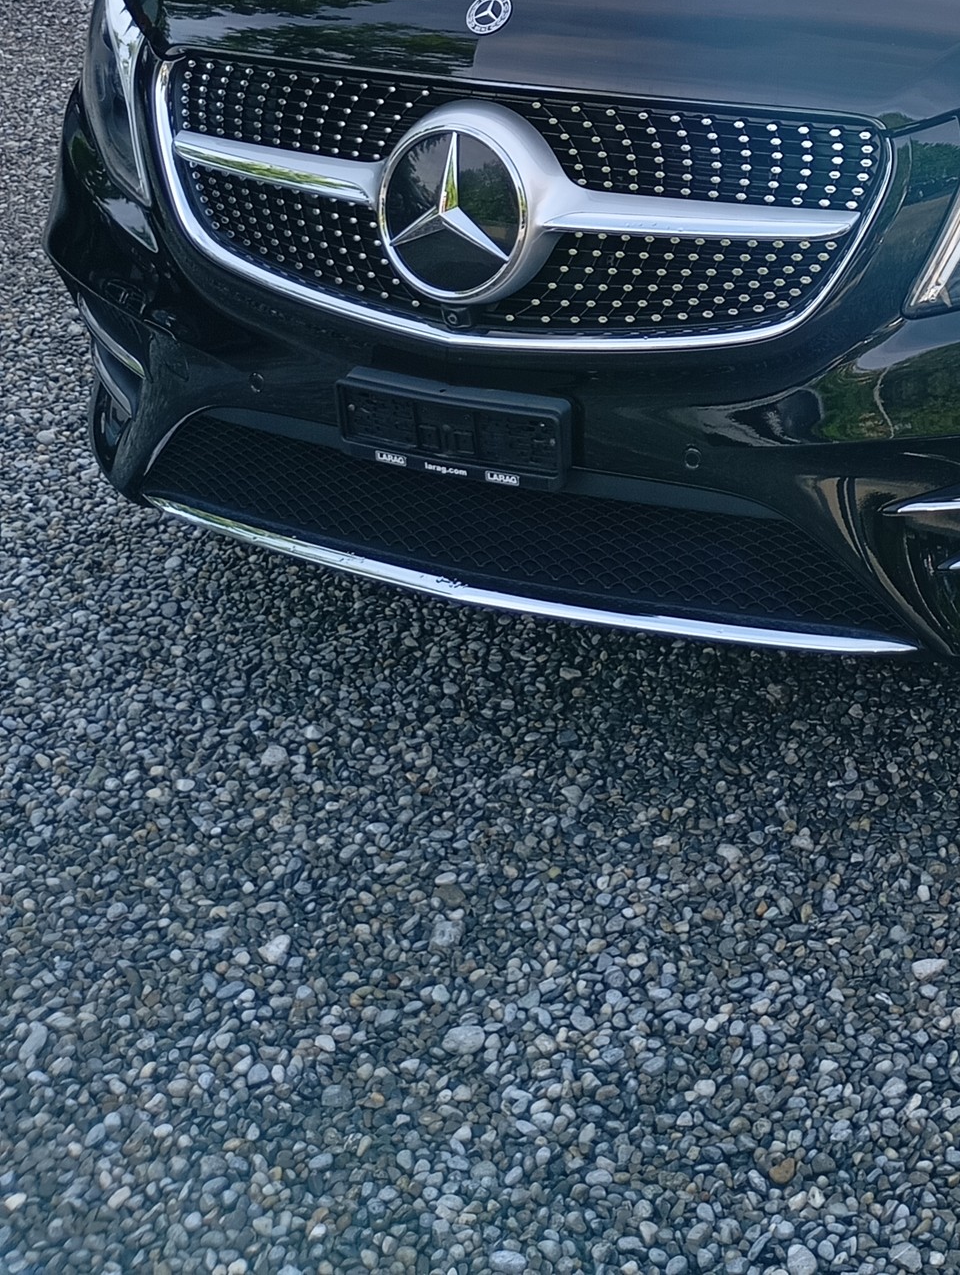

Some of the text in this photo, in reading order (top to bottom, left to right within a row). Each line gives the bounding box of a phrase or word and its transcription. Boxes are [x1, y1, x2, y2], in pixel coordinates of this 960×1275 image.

[377, 451, 517, 484] LARAG larag.com LARAG
